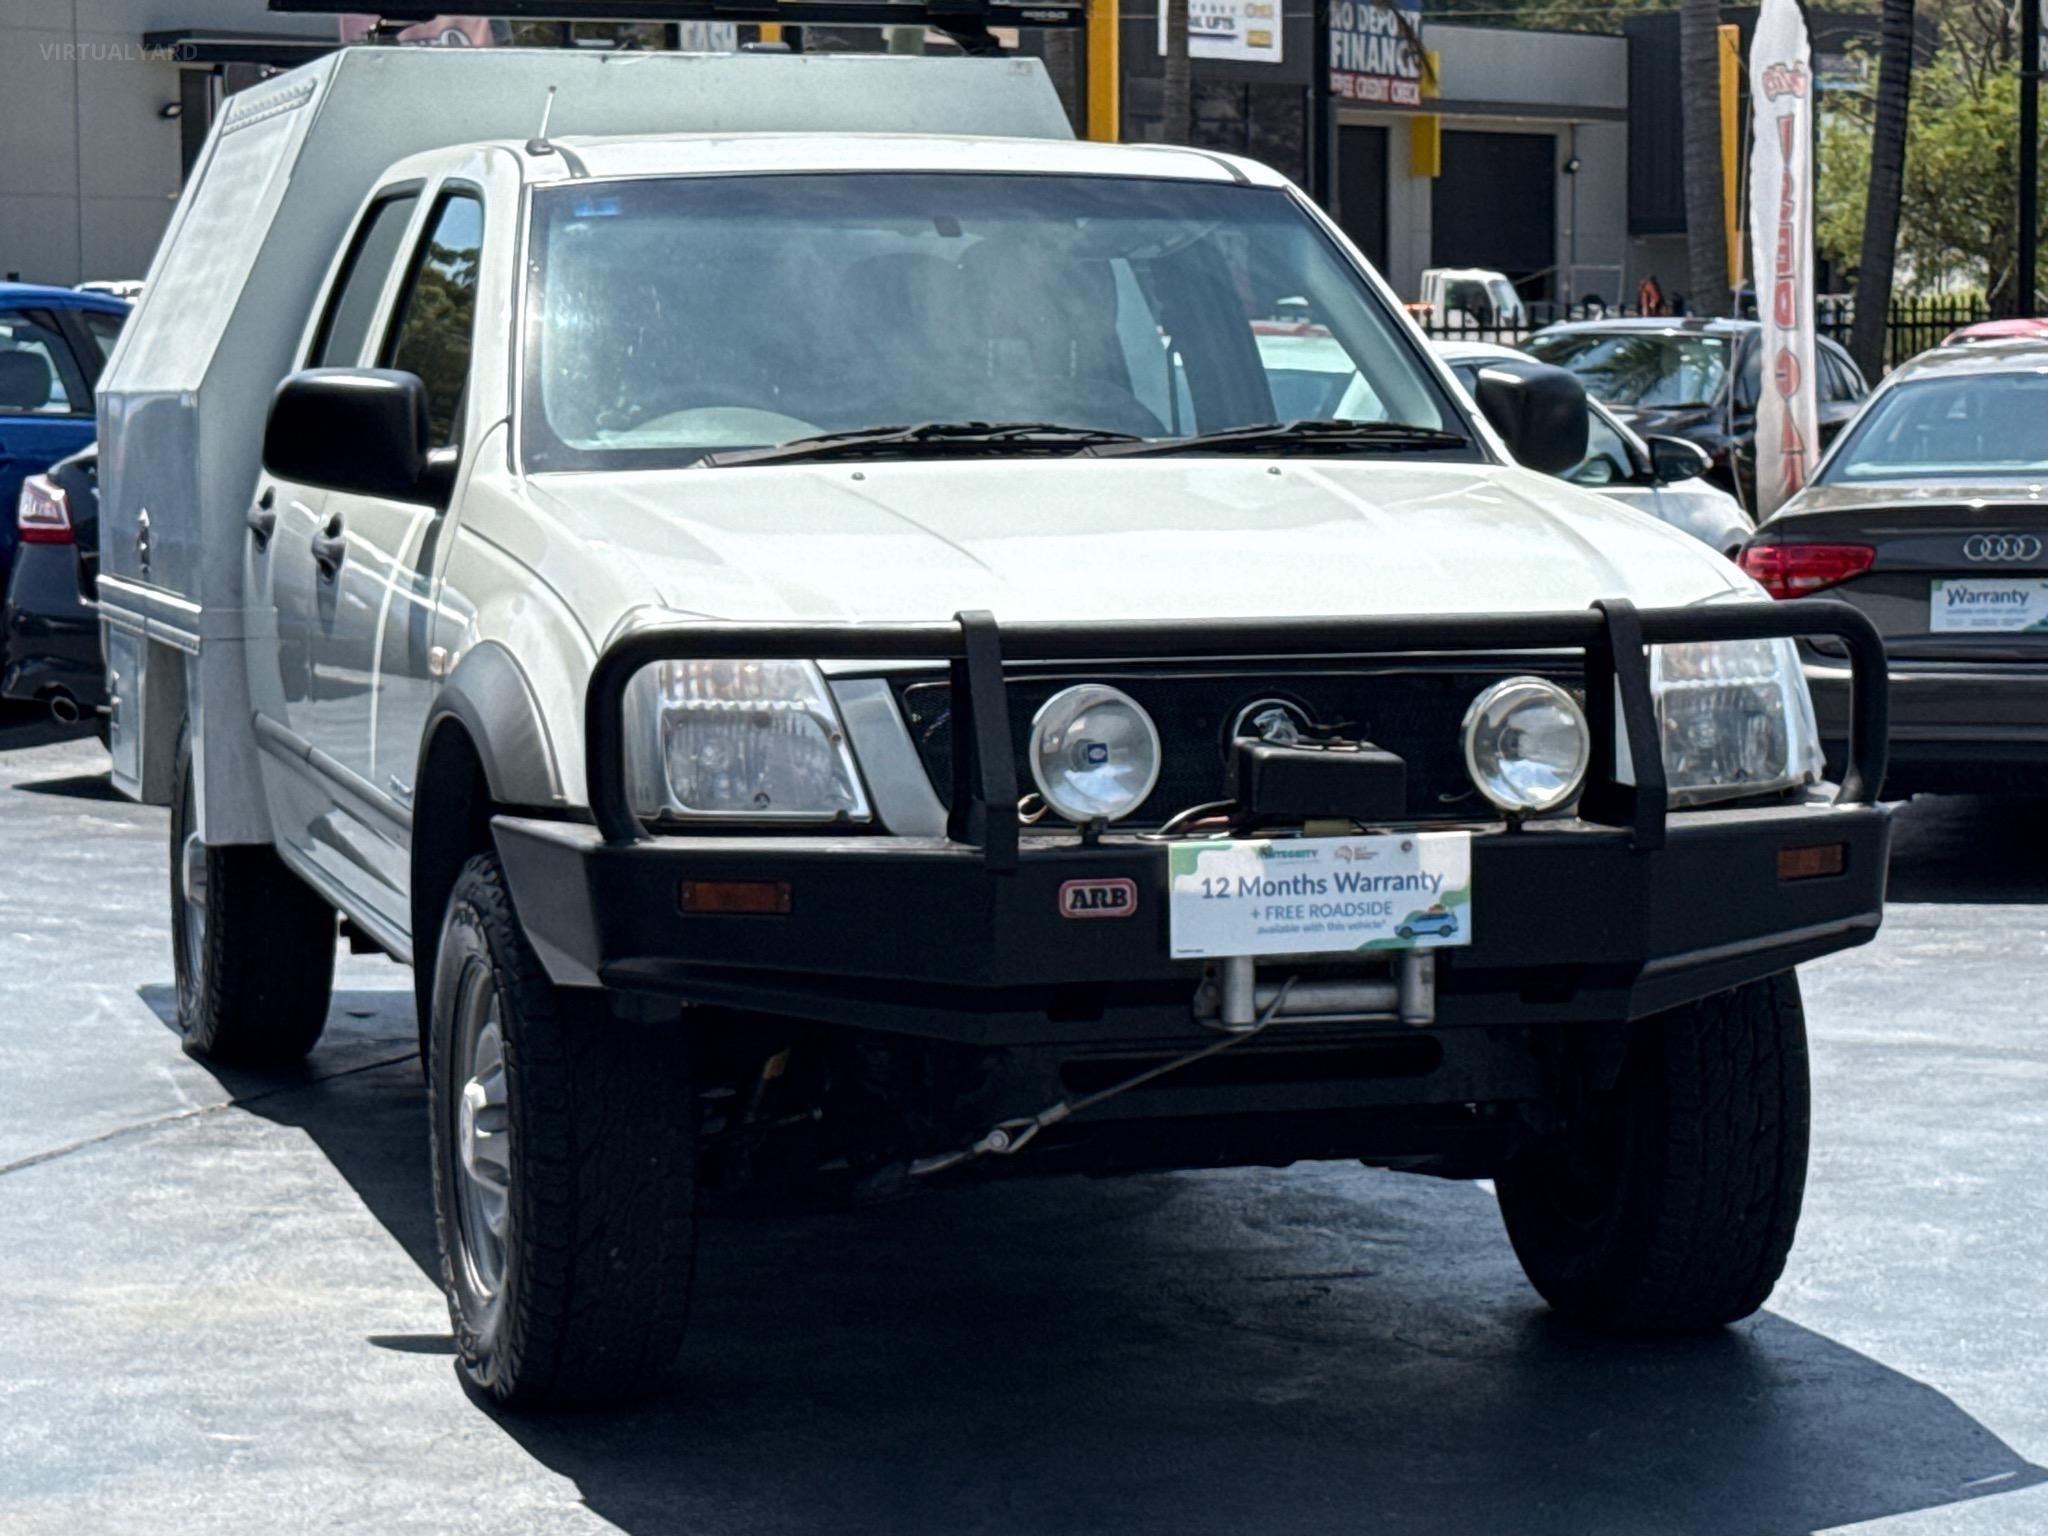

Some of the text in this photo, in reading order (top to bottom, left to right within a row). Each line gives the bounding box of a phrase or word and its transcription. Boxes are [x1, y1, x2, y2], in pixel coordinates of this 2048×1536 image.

[1329, 0, 1354, 31] NO
[1946, 586, 2030, 607] Warranty
[1201, 871, 1443, 899] 12 Months Warranty
[1071, 887, 1128, 909] ARB
[1265, 905, 1305, 920] FREE
[1309, 901, 1393, 918] ROADSIDE
